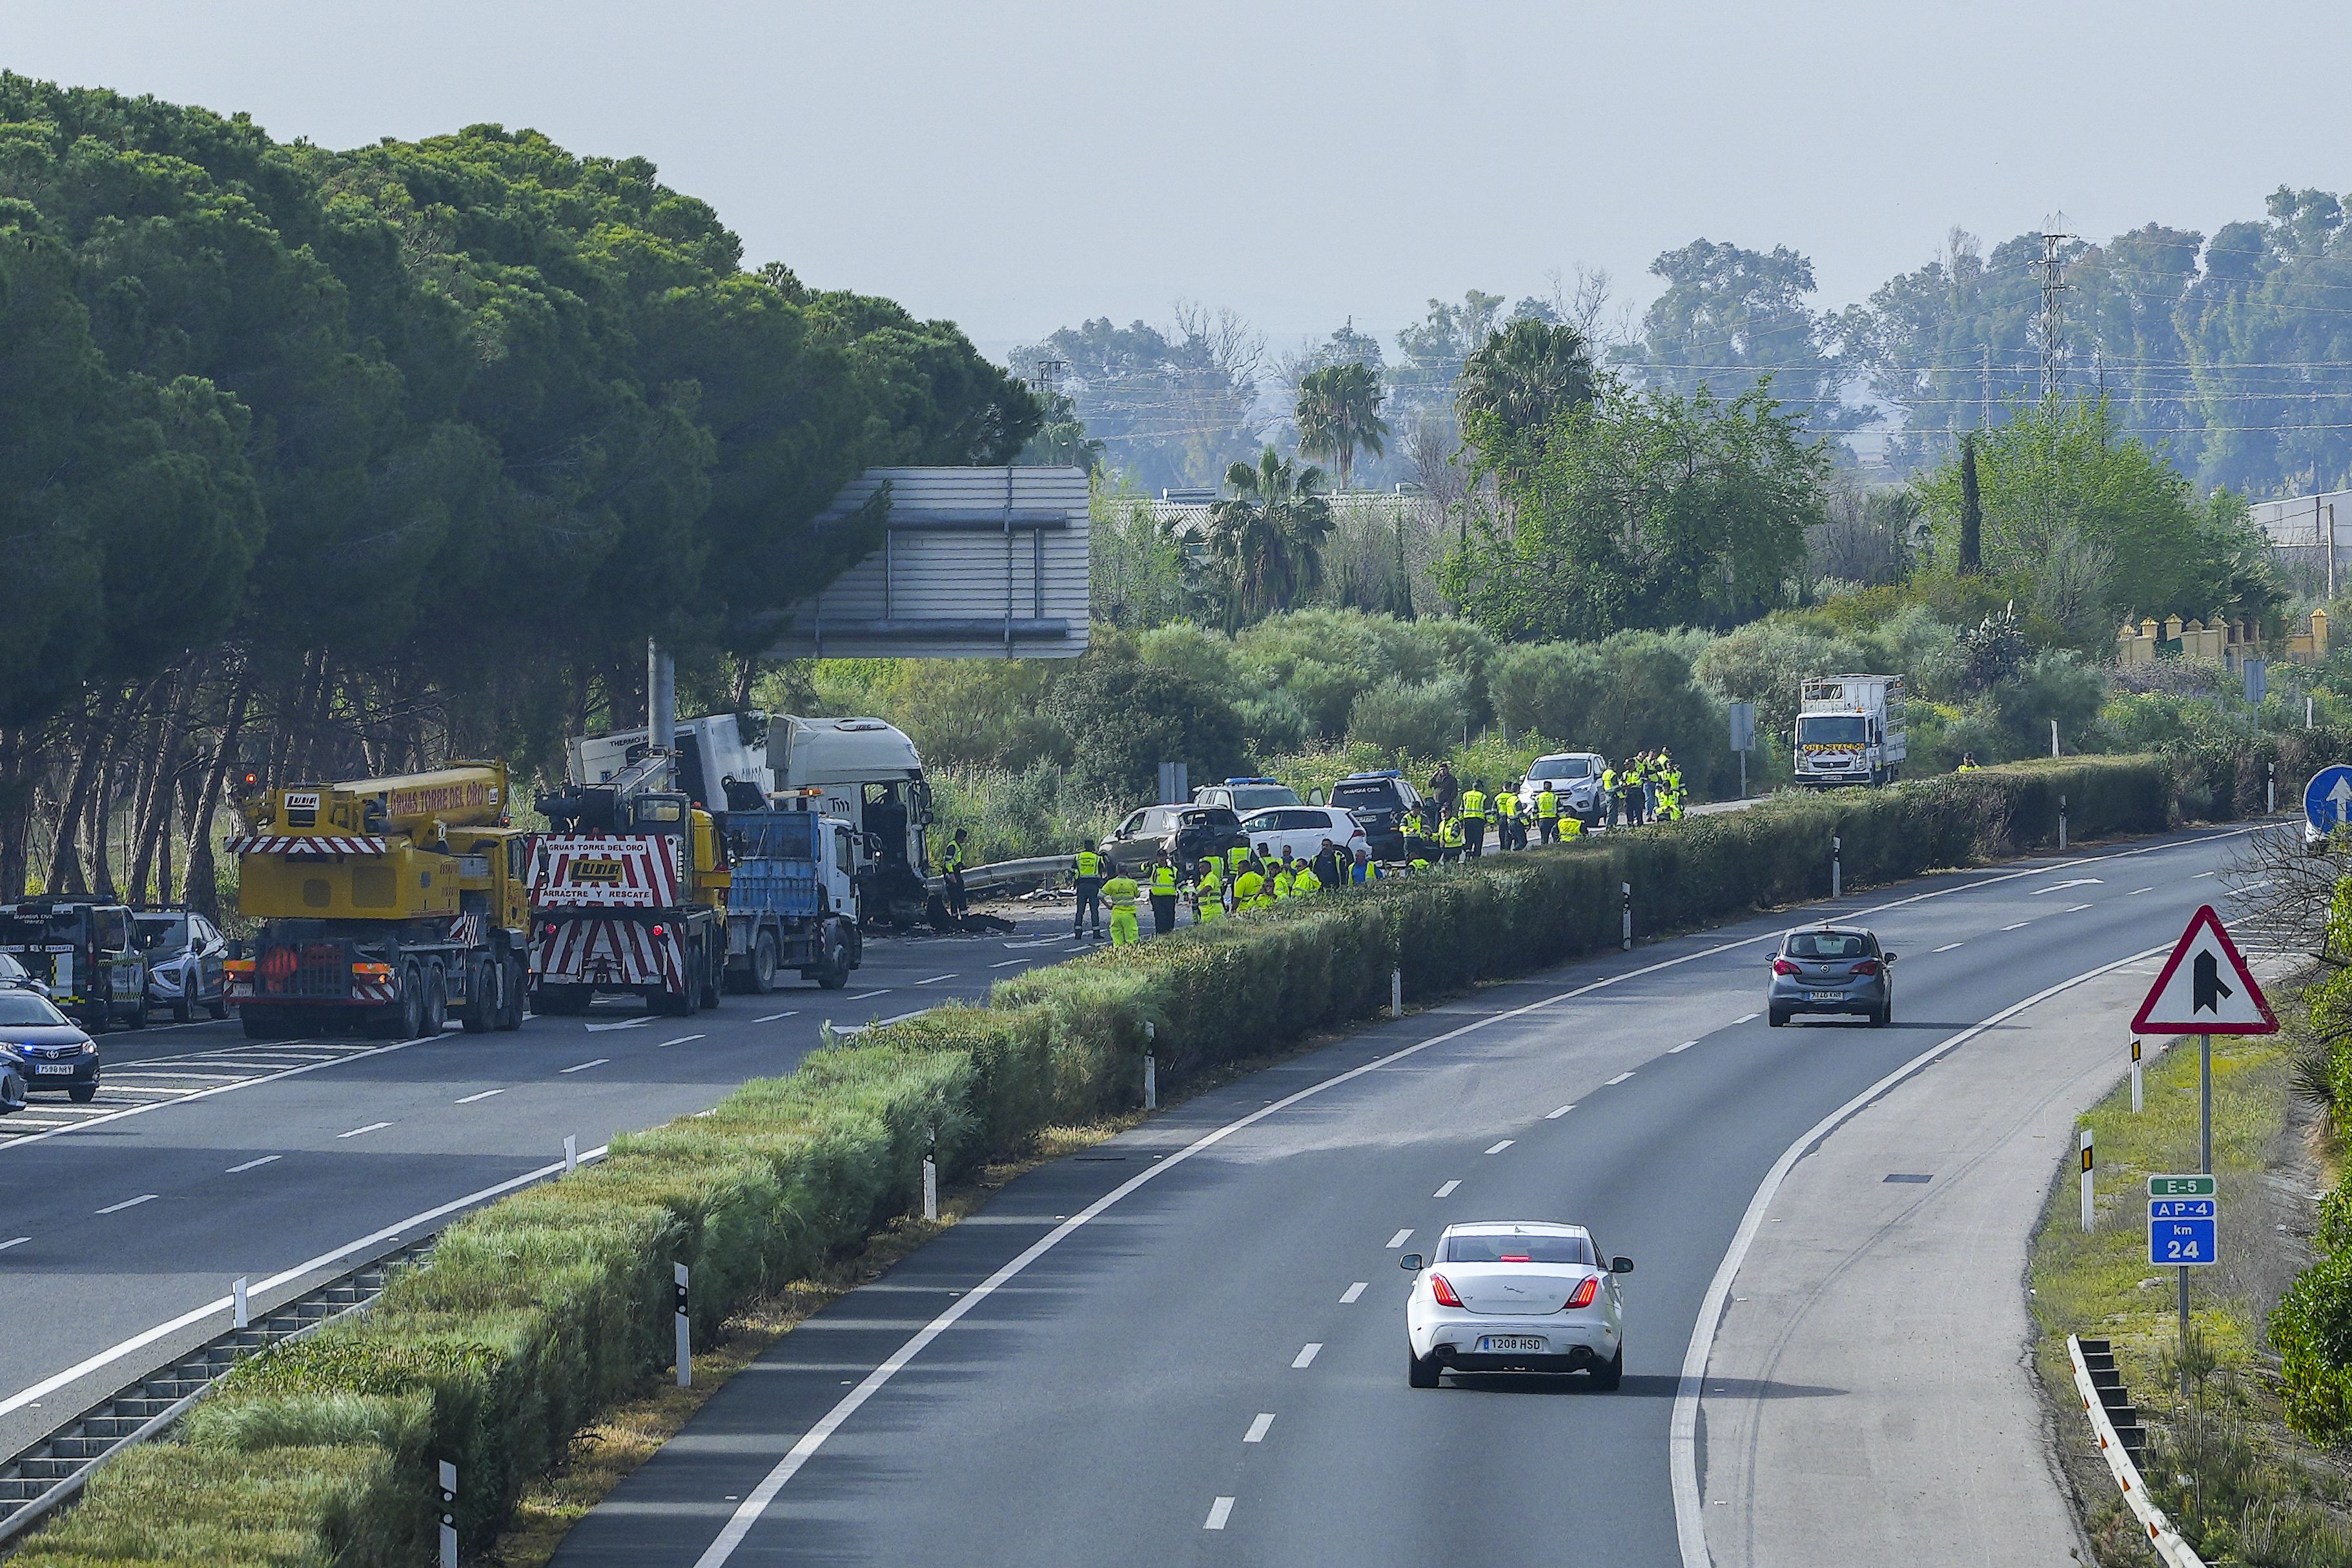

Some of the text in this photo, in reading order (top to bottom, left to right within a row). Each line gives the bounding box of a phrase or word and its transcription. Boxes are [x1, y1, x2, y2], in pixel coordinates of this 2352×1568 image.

[610, 737, 640, 746] THERMO
[420, 788, 447, 813] TORRE
[450, 786, 464, 808] DEL
[466, 782, 484, 806] ORO
[2167, 1180, 2197, 1193] E-5
[2158, 1203, 2207, 1216] AP-4
[2173, 1225, 2193, 1235] km
[2167, 1240, 2200, 1259] 24
[1492, 1339, 1540, 1349] 1208 HSD
